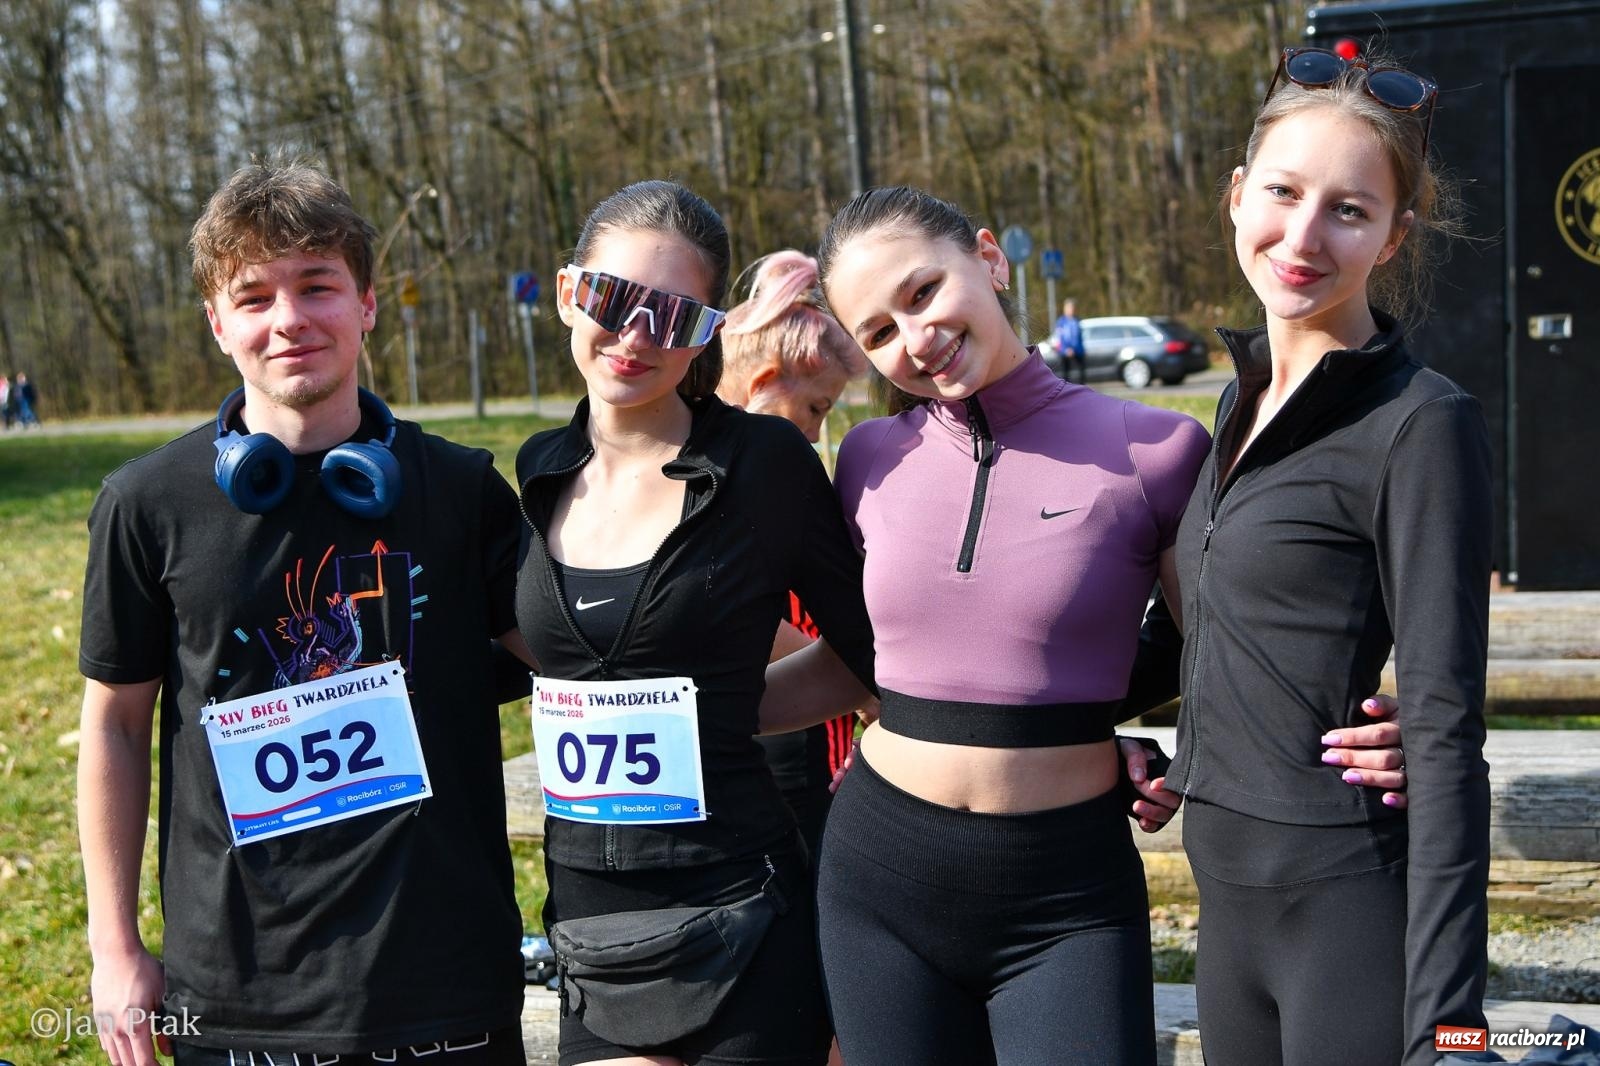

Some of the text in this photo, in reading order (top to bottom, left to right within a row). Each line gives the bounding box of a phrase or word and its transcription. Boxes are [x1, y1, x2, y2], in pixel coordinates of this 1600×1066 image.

[218, 675, 389, 727] XIV BIEG TWARDZIELA
[540, 691, 680, 707] XIV BIEG TWARDZIELA
[539, 707, 584, 718] 15 marzec 2026
[221, 715, 291, 739] 15 marzec 2026
[254, 720, 385, 794] 052
[557, 731, 661, 786] 075
[347, 788, 382, 803] Racibórz
[622, 804, 656, 813] Racibórz
[663, 803, 682, 811] OSiR
